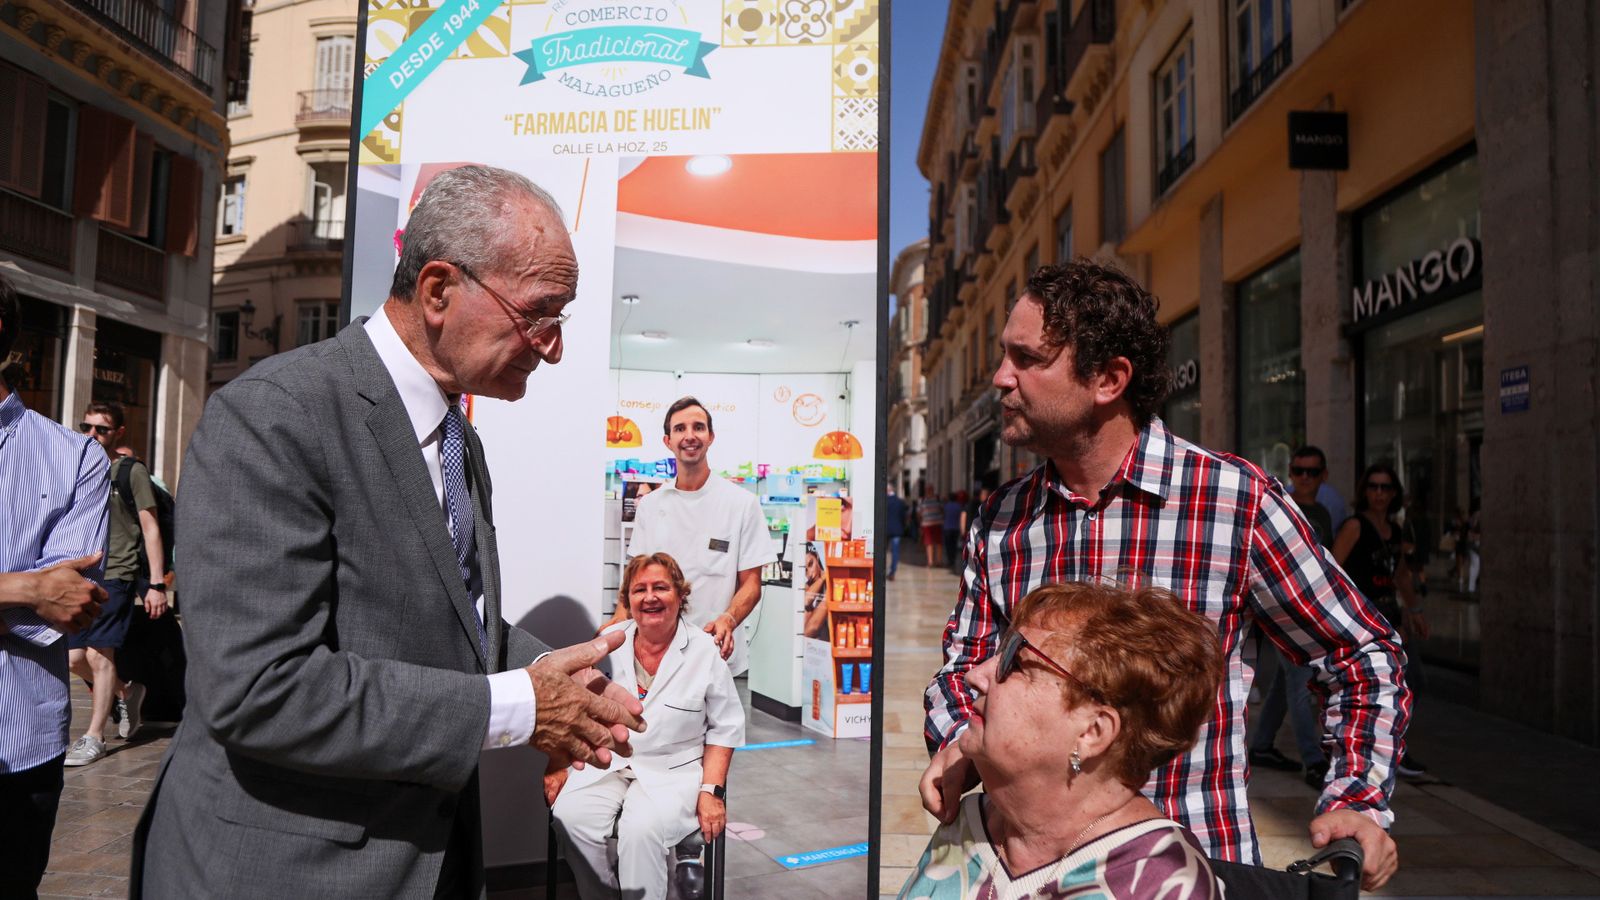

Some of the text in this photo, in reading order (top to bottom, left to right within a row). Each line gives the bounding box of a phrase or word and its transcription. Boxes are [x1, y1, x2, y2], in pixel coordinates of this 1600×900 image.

[566, 6, 668, 26] COMERCIO
[389, 0, 479, 89] DESDE 1944
[542, 33, 689, 67] Tradicional
[557, 69, 671, 97] MALAGUEÑO
[504, 107, 722, 136] “FARMACIA DE HUELIN”
[553, 141, 668, 155] CALLE LA HOZ, 25
[1295, 133, 1343, 145] MANGO
[1353, 236, 1475, 323] MANGO
[94, 368, 125, 384] UAREZ
[844, 715, 871, 725] VICHY
